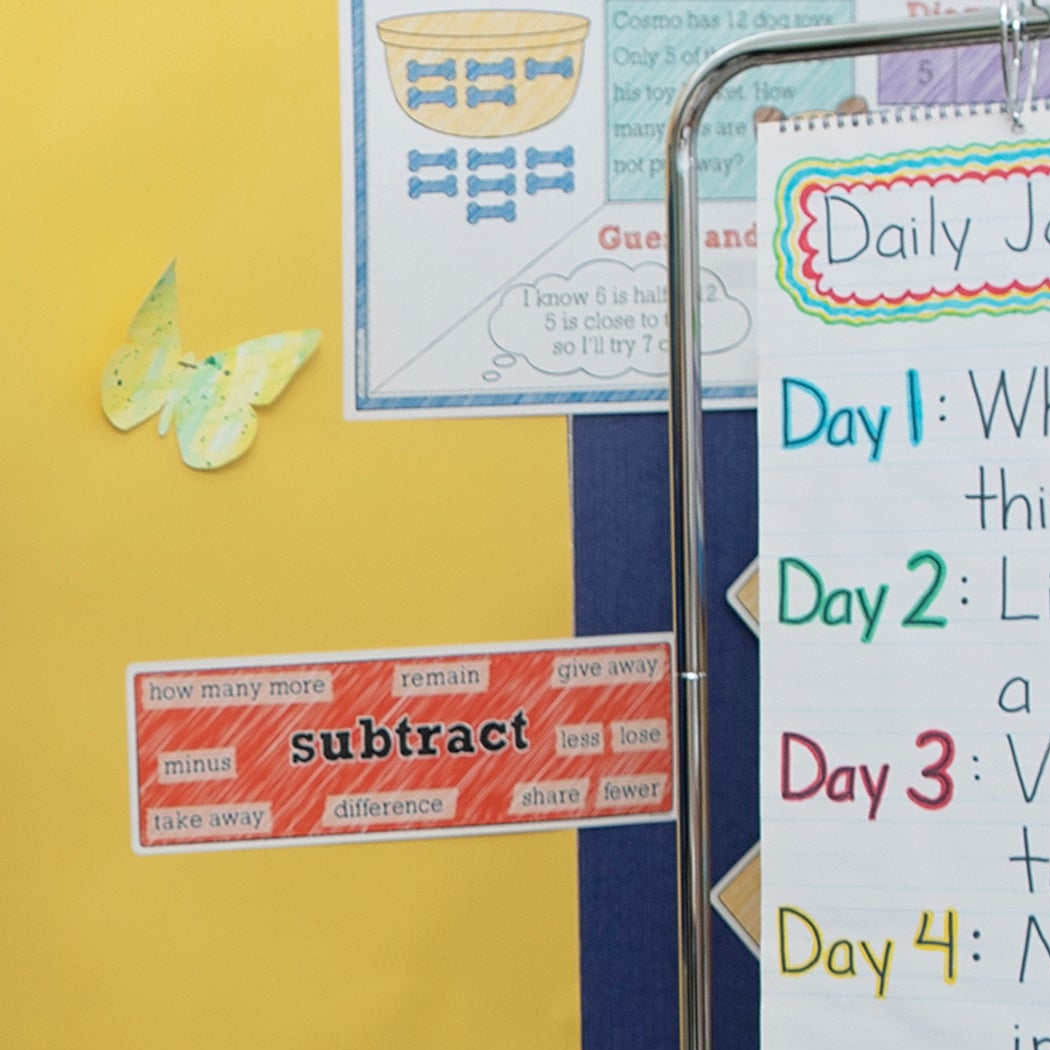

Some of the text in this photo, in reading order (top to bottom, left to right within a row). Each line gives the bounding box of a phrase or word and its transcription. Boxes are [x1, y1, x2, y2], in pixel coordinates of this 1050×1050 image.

[613, 11, 682, 30] Cosmo
[687, 11, 721, 28] has
[728, 11, 747, 27] 12
[753, 10, 791, 29] dog
[613, 47, 658, 71] Only
[917, 59, 934, 84] 5
[613, 84, 641, 100] his
[753, 81, 798, 99] How
[613, 122, 666, 144] many
[716, 124, 747, 137] are
[613, 157, 650, 174] not
[699, 153, 744, 177] way?
[598, 223, 757, 250] Gue and
[824, 195, 971, 271] Daily
[536, 289, 589, 307] know
[596, 286, 607, 304] 6
[613, 286, 628, 304] is
[700, 284, 718, 302] 2
[545, 312, 557, 331] 5
[562, 313, 578, 331] is
[584, 312, 635, 330] close
[641, 312, 659, 328] to
[553, 341, 576, 355] so
[610, 338, 636, 358] try
[642, 334, 653, 352] 7
[782, 376, 891, 463] Day
[778, 556, 890, 644] Day
[401, 666, 481, 688] remain
[557, 656, 659, 685] give away
[149, 677, 326, 706] how many more
[998, 675, 1032, 714] a
[289, 709, 530, 765] subtract
[561, 729, 600, 749] less
[620, 724, 662, 745] lose
[165, 754, 232, 777] minus
[780, 731, 890, 822] Day
[521, 785, 580, 808] share
[604, 779, 660, 802] fewer
[334, 794, 444, 821] difference
[153, 809, 265, 833] take away
[777, 905, 896, 1000] Day
